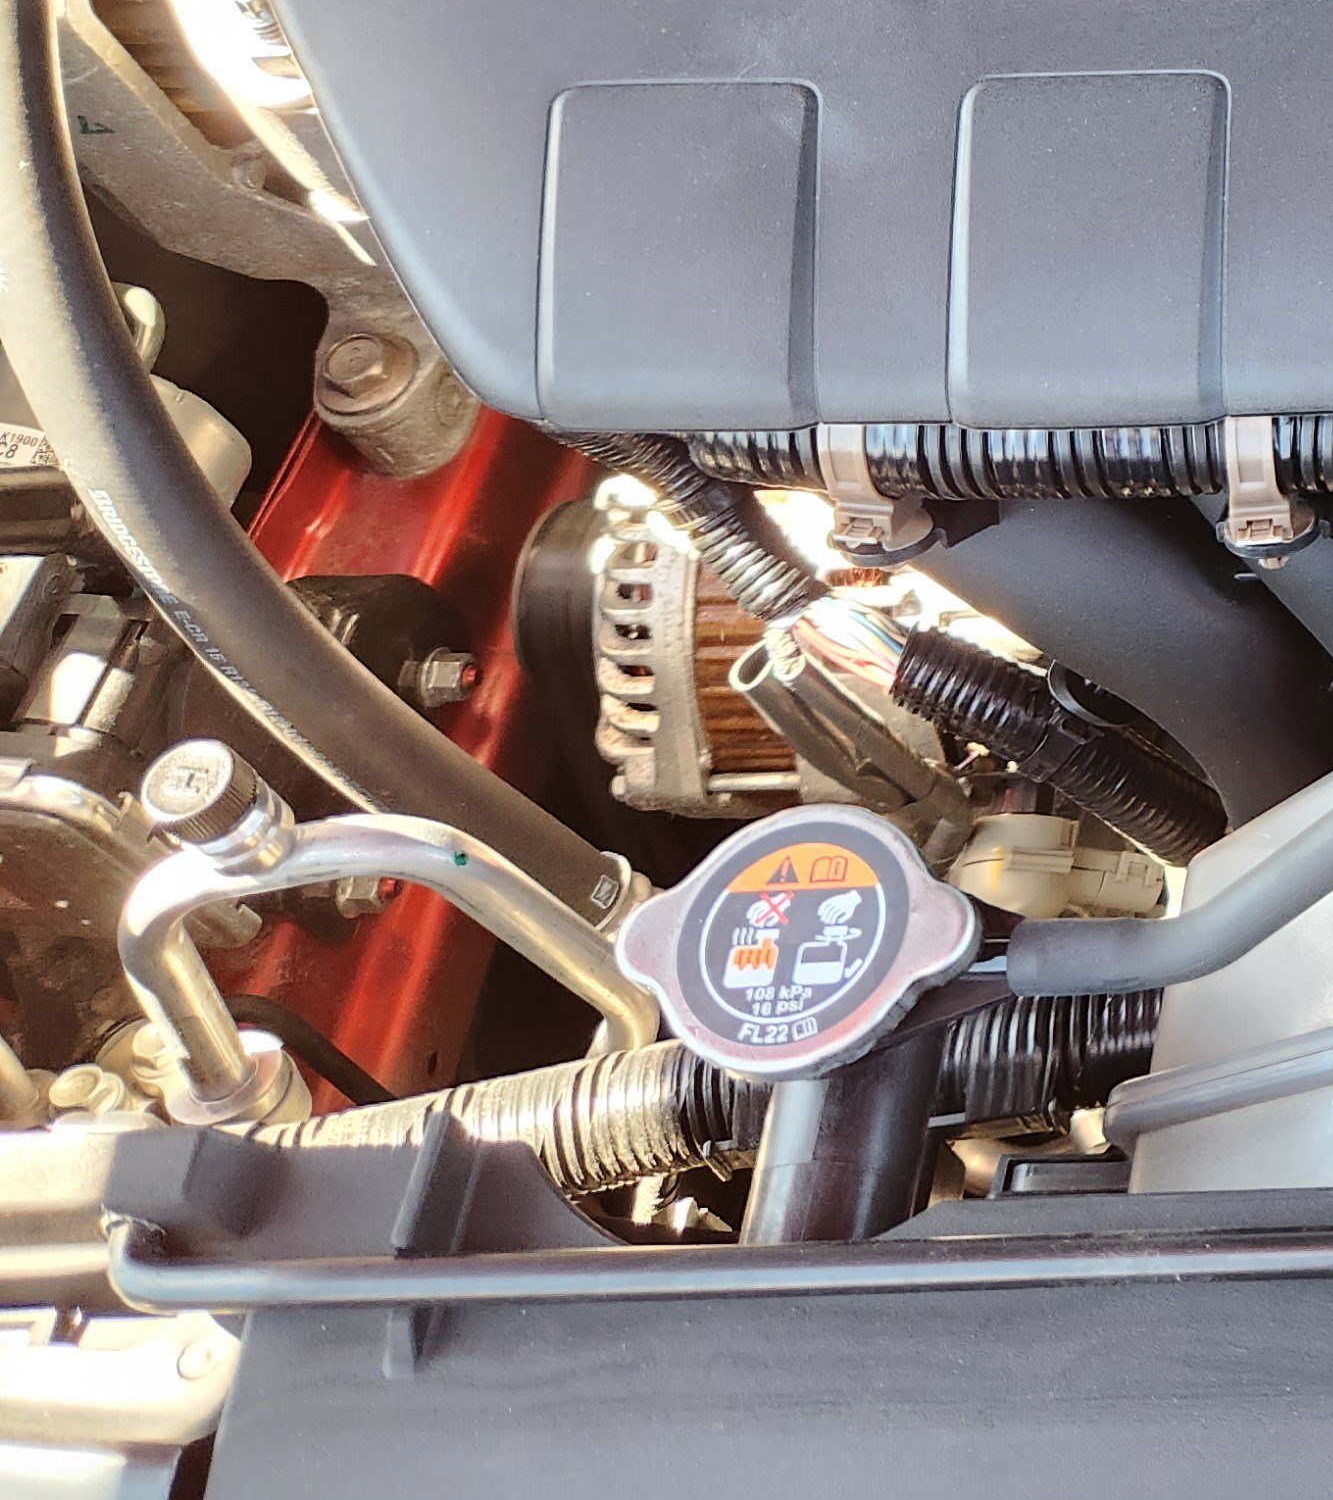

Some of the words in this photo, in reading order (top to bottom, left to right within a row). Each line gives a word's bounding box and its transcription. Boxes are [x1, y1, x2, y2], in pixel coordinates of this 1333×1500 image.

[87, 488, 179, 605] BRIDGESTONE
[173, 610, 209, 643] E-CR
[744, 986, 776, 1002] 108
[778, 984, 813, 1001] kPa
[751, 1001, 773, 1017] 16
[775, 995, 805, 1016] psi
[737, 1022, 790, 1045] FL22
